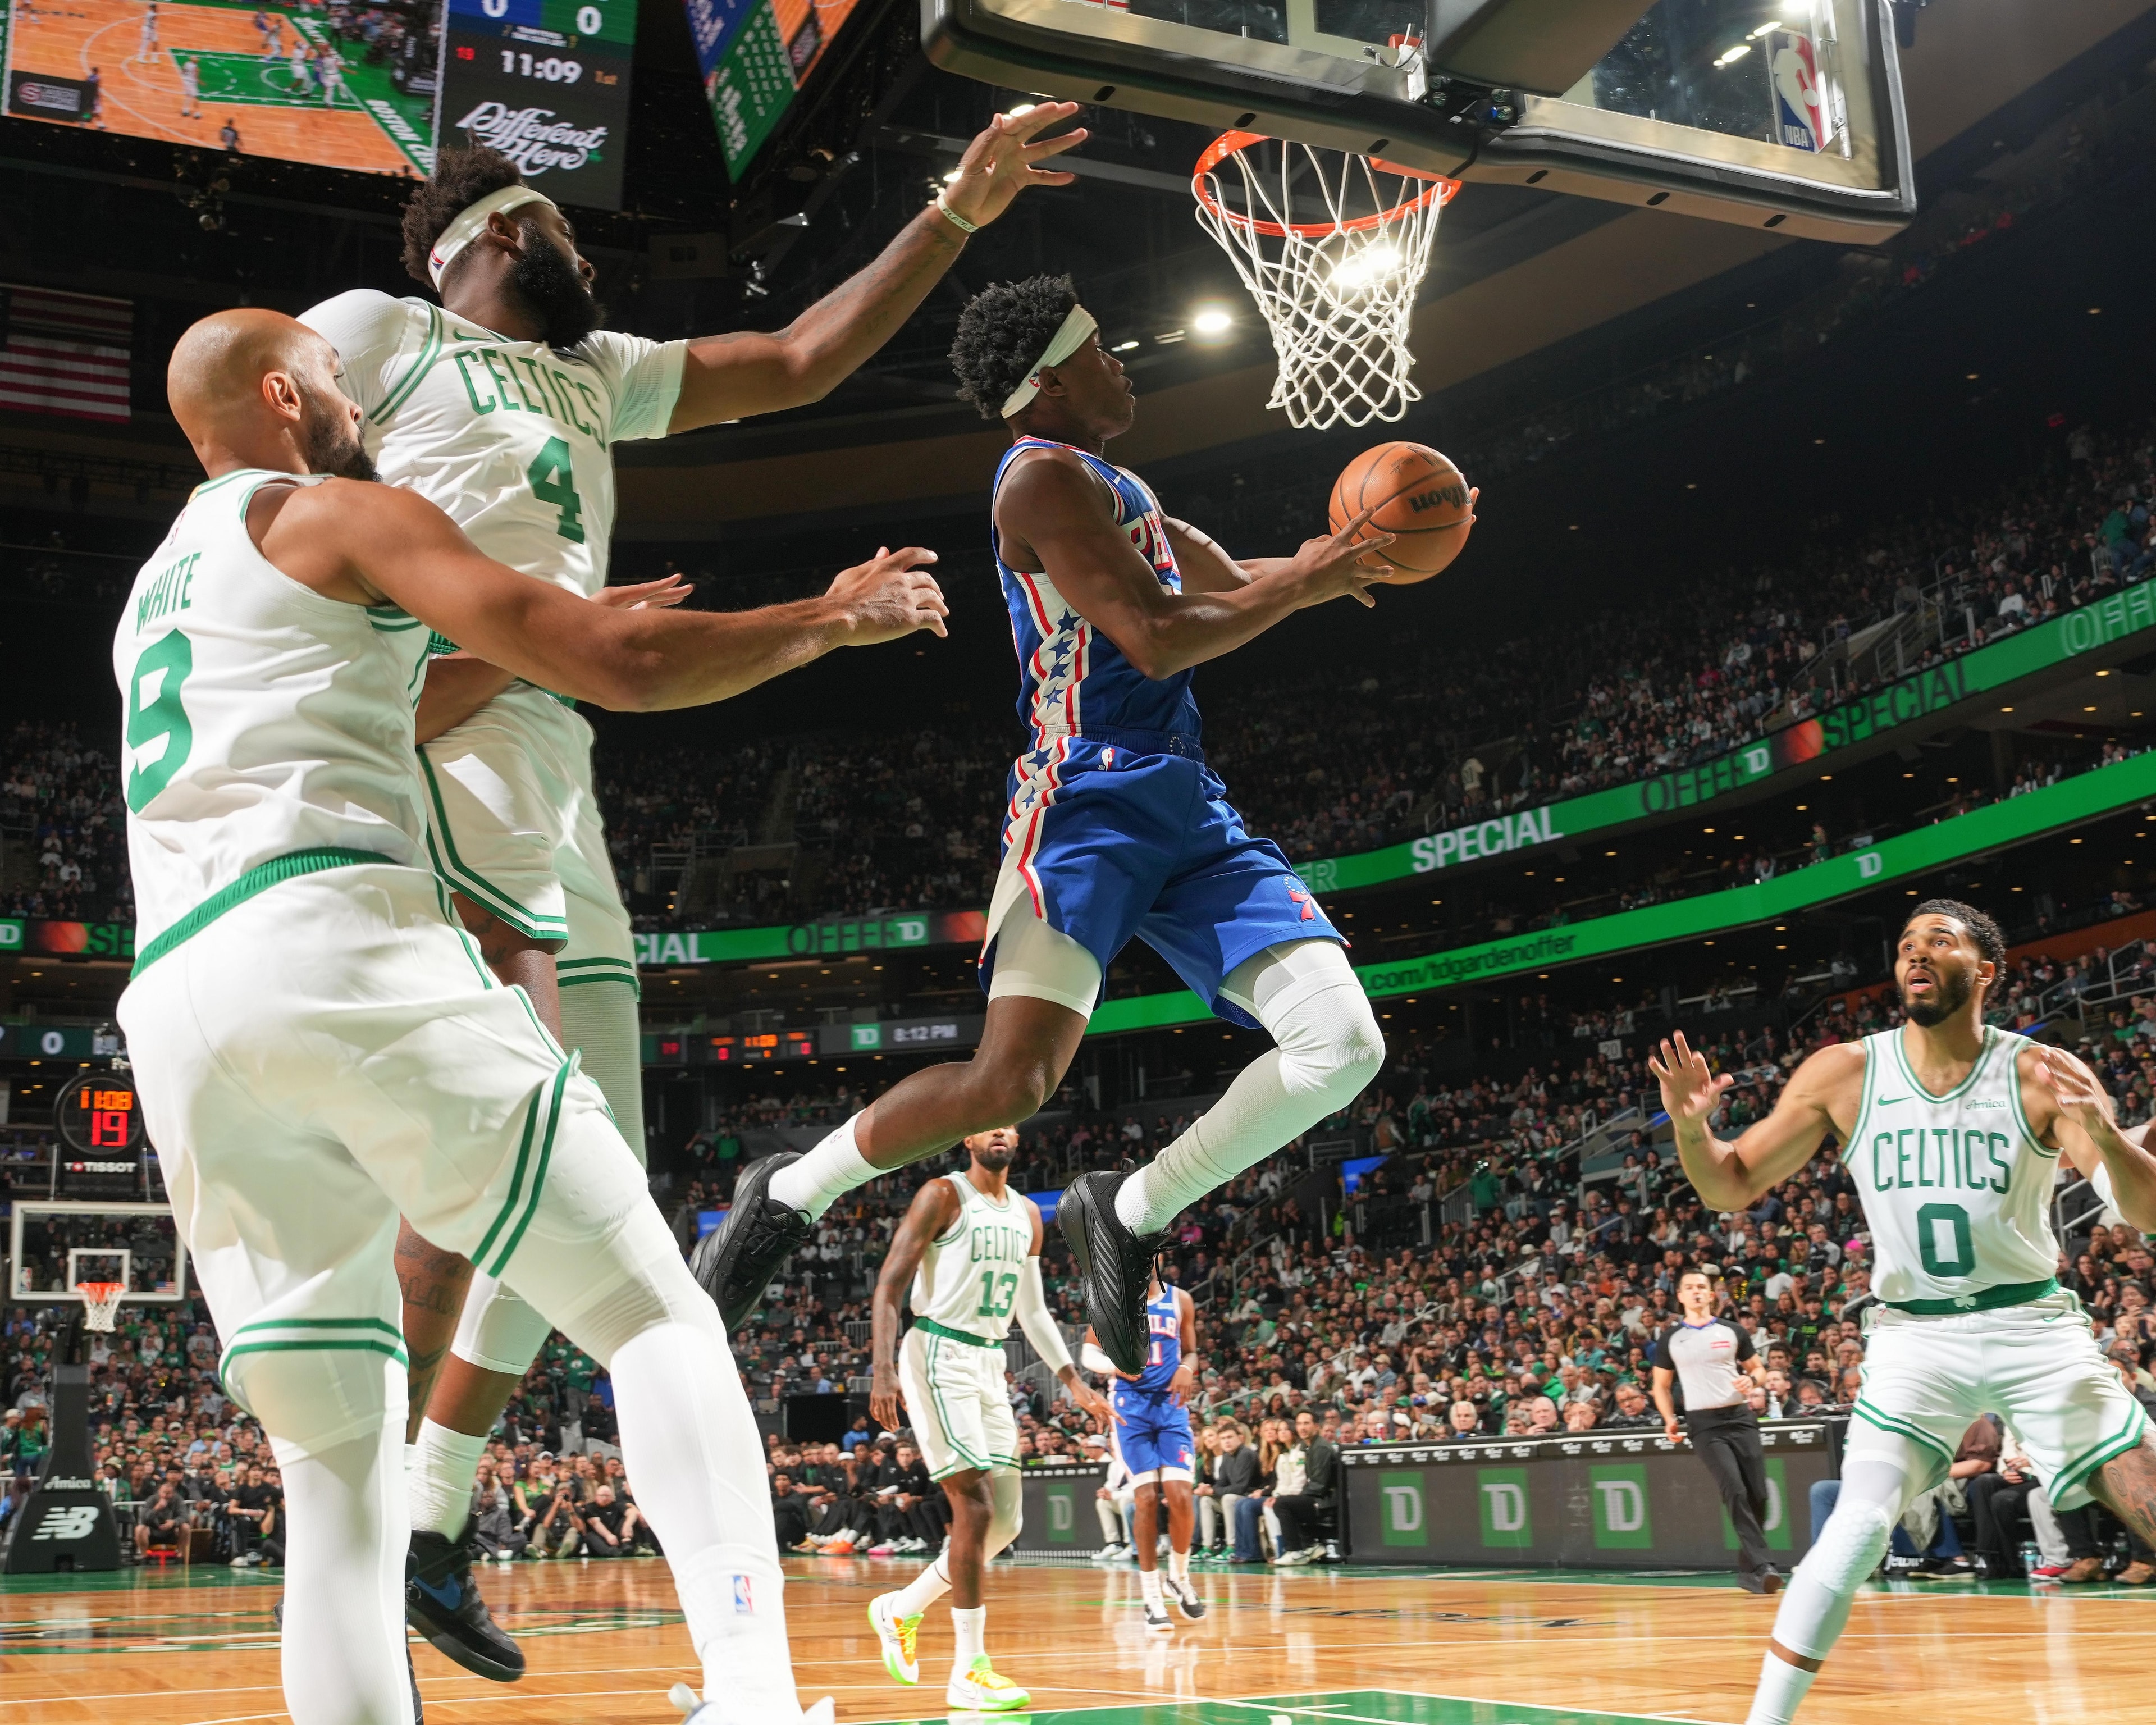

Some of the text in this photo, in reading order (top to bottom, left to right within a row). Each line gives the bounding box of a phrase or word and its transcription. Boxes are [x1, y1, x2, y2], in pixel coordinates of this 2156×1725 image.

[576, 6, 602, 35] 0
[501, 50, 583, 84] 11:09
[455, 102, 609, 149] Different
[1784, 125, 1810, 147] NBA
[501, 141, 589, 176] Here
[454, 348, 606, 453] CELTICS
[527, 436, 584, 545] 4
[136, 552, 202, 636] WHITE
[127, 628, 193, 815] 9
[1411, 806, 1565, 873] SPECIAL
[1853, 852, 1883, 878] TD
[41, 1031, 65, 1055] 0
[1966, 1099, 2006, 1110] Amica
[92, 1111, 128, 1147] 19
[84, 1162, 137, 1172] TISSOT
[1874, 1128, 2011, 1194] CELTICS
[1917, 1203, 1976, 1277] 0
[977, 1270, 1018, 1317] 13
[44, 1475, 92, 1490] Amica
[1594, 1480, 1645, 1531] TD
[1383, 1486, 1422, 1531] TD
[1481, 1483, 1525, 1531] TD
